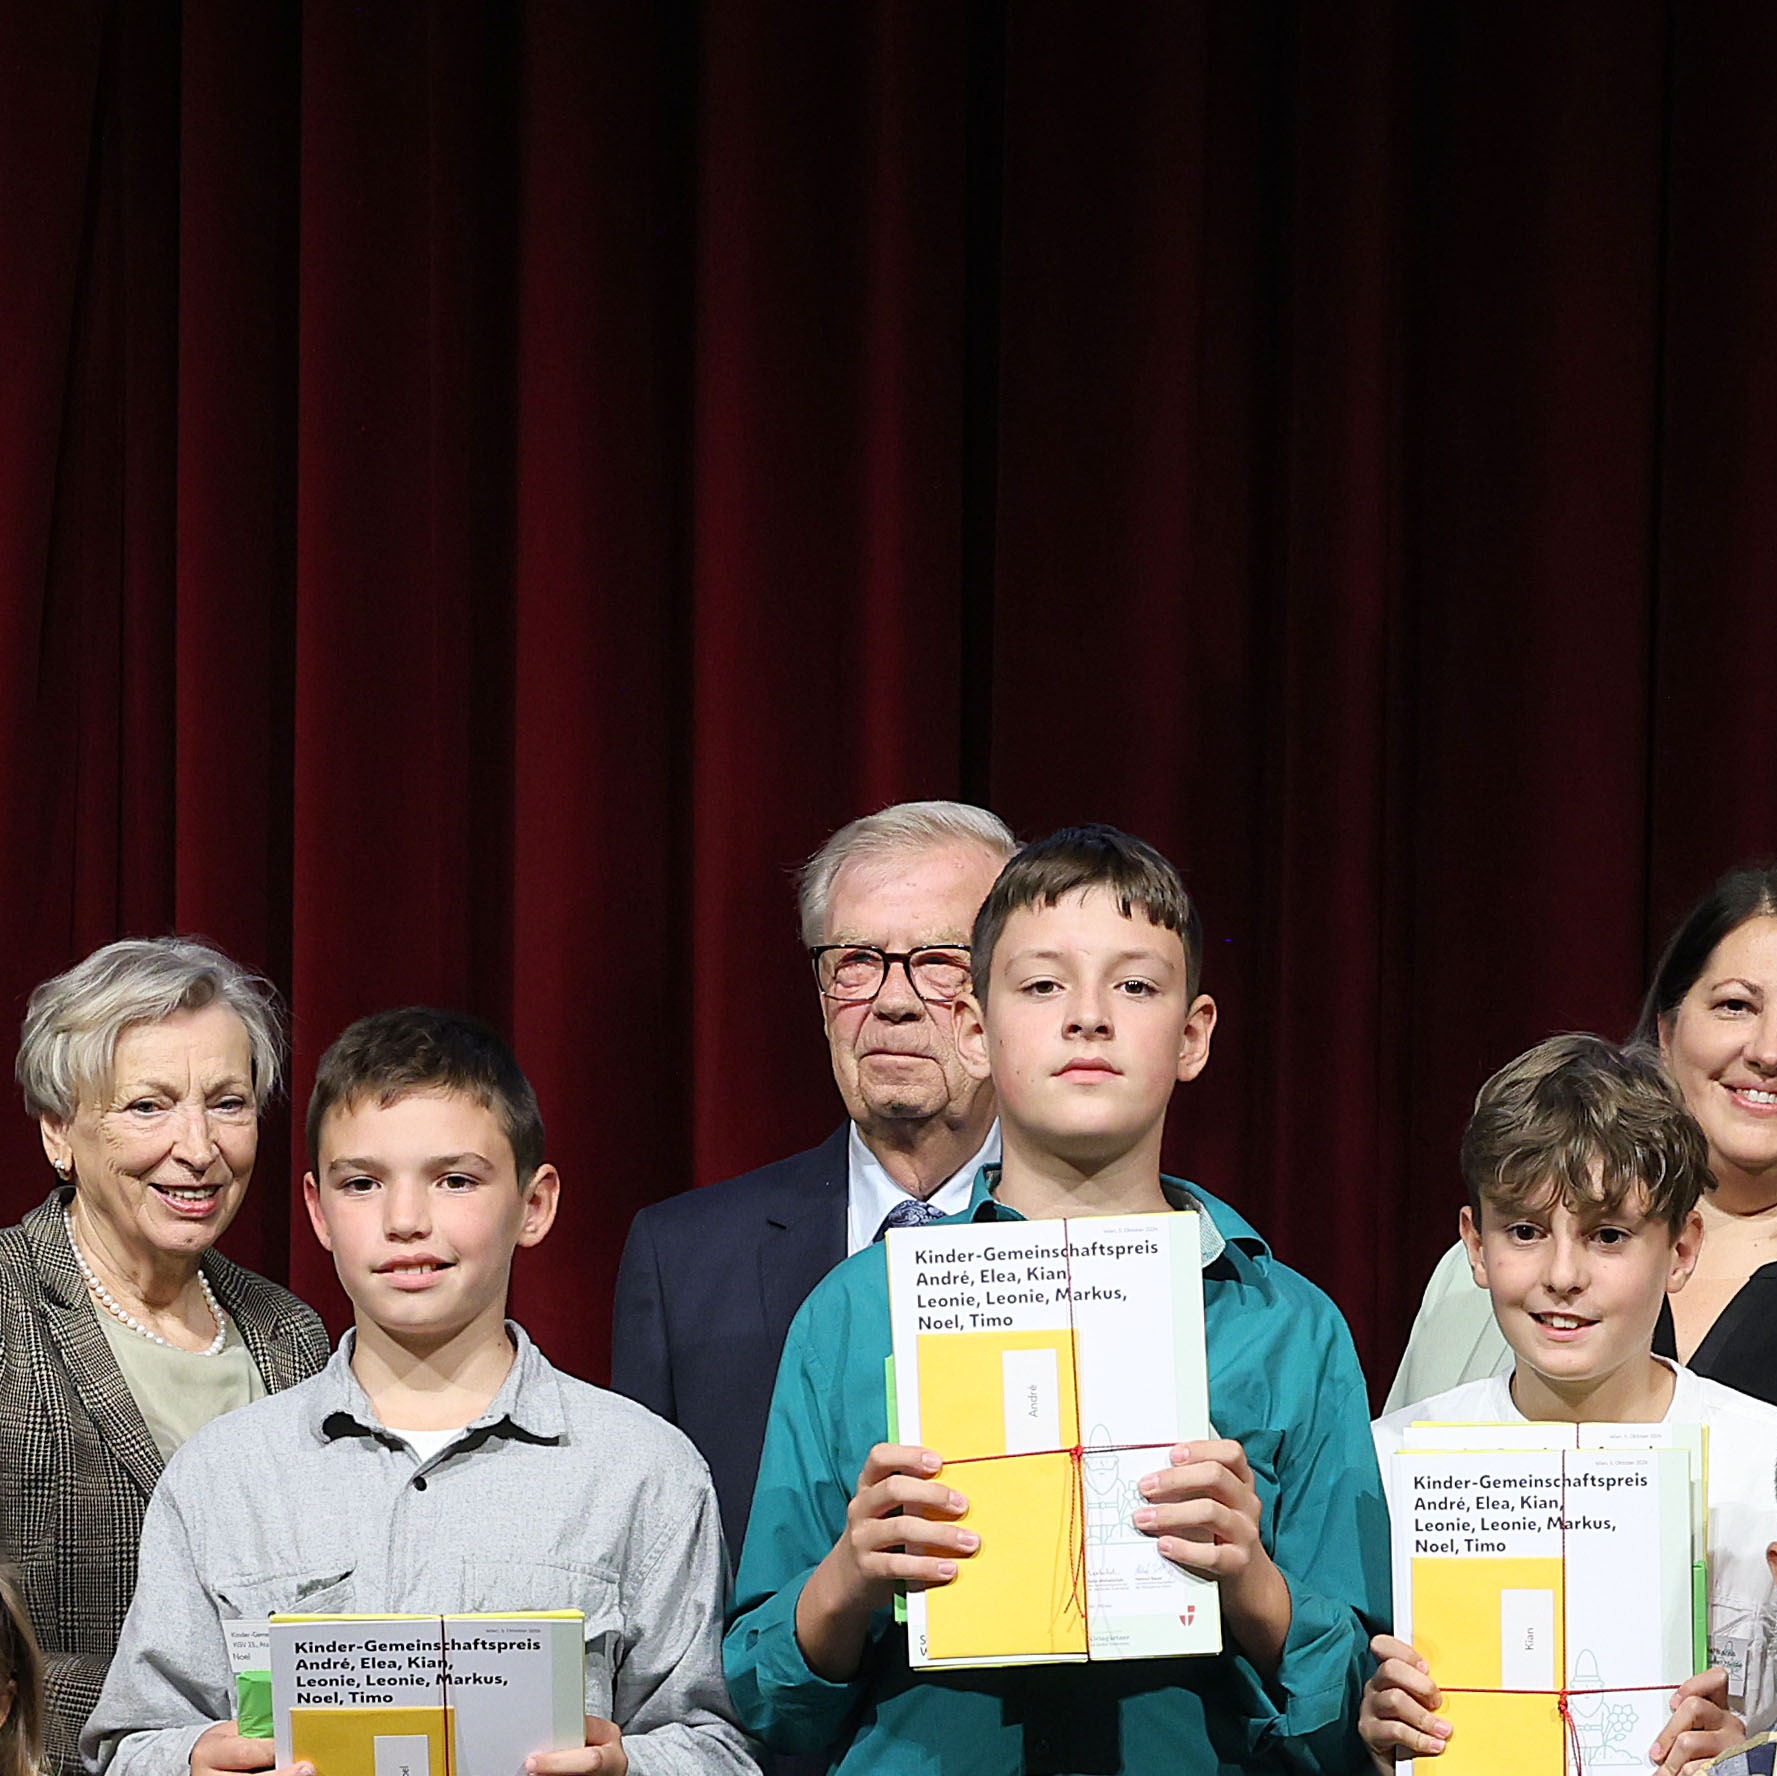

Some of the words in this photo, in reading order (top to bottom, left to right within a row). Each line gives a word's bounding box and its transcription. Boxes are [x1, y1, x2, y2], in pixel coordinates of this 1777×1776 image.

[915, 1239, 1159, 1265] Kinder-Gemeinschaftspreis
[916, 1270, 975, 1287] André,
[980, 1268, 1021, 1284] Elea,
[917, 1292, 981, 1309] Leonie,
[986, 1288, 1050, 1305] Leonie,
[1055, 1285, 1127, 1305] Markus,
[918, 1314, 964, 1331] Noel,
[969, 1313, 1013, 1328] Timo
[1028, 1384, 1038, 1418] André
[1414, 1472, 1648, 1492] Kinder-Gemeinschaftspreis
[1414, 1496, 1471, 1513] André,
[1476, 1495, 1515, 1512] Elea,
[1520, 1493, 1565, 1512] Kian,
[1414, 1517, 1476, 1534] Leonie,
[1480, 1516, 1542, 1533] Leonie,
[1547, 1514, 1616, 1533] Markus,
[1415, 1538, 1459, 1555] Noel,
[1463, 1538, 1506, 1553] Timo
[295, 1636, 541, 1655] Kinder-Gemeinschaftspreis
[1524, 1626, 1534, 1651] Kian
[295, 1657, 355, 1672] André,
[360, 1656, 402, 1671] Elea,
[407, 1655, 453, 1671] Kian,
[296, 1674, 361, 1689] Leonie,
[366, 1673, 430, 1688] Leonie,
[435, 1672, 508, 1688] Markus,
[297, 1691, 344, 1706] Noel,
[348, 1691, 394, 1704] Timo
